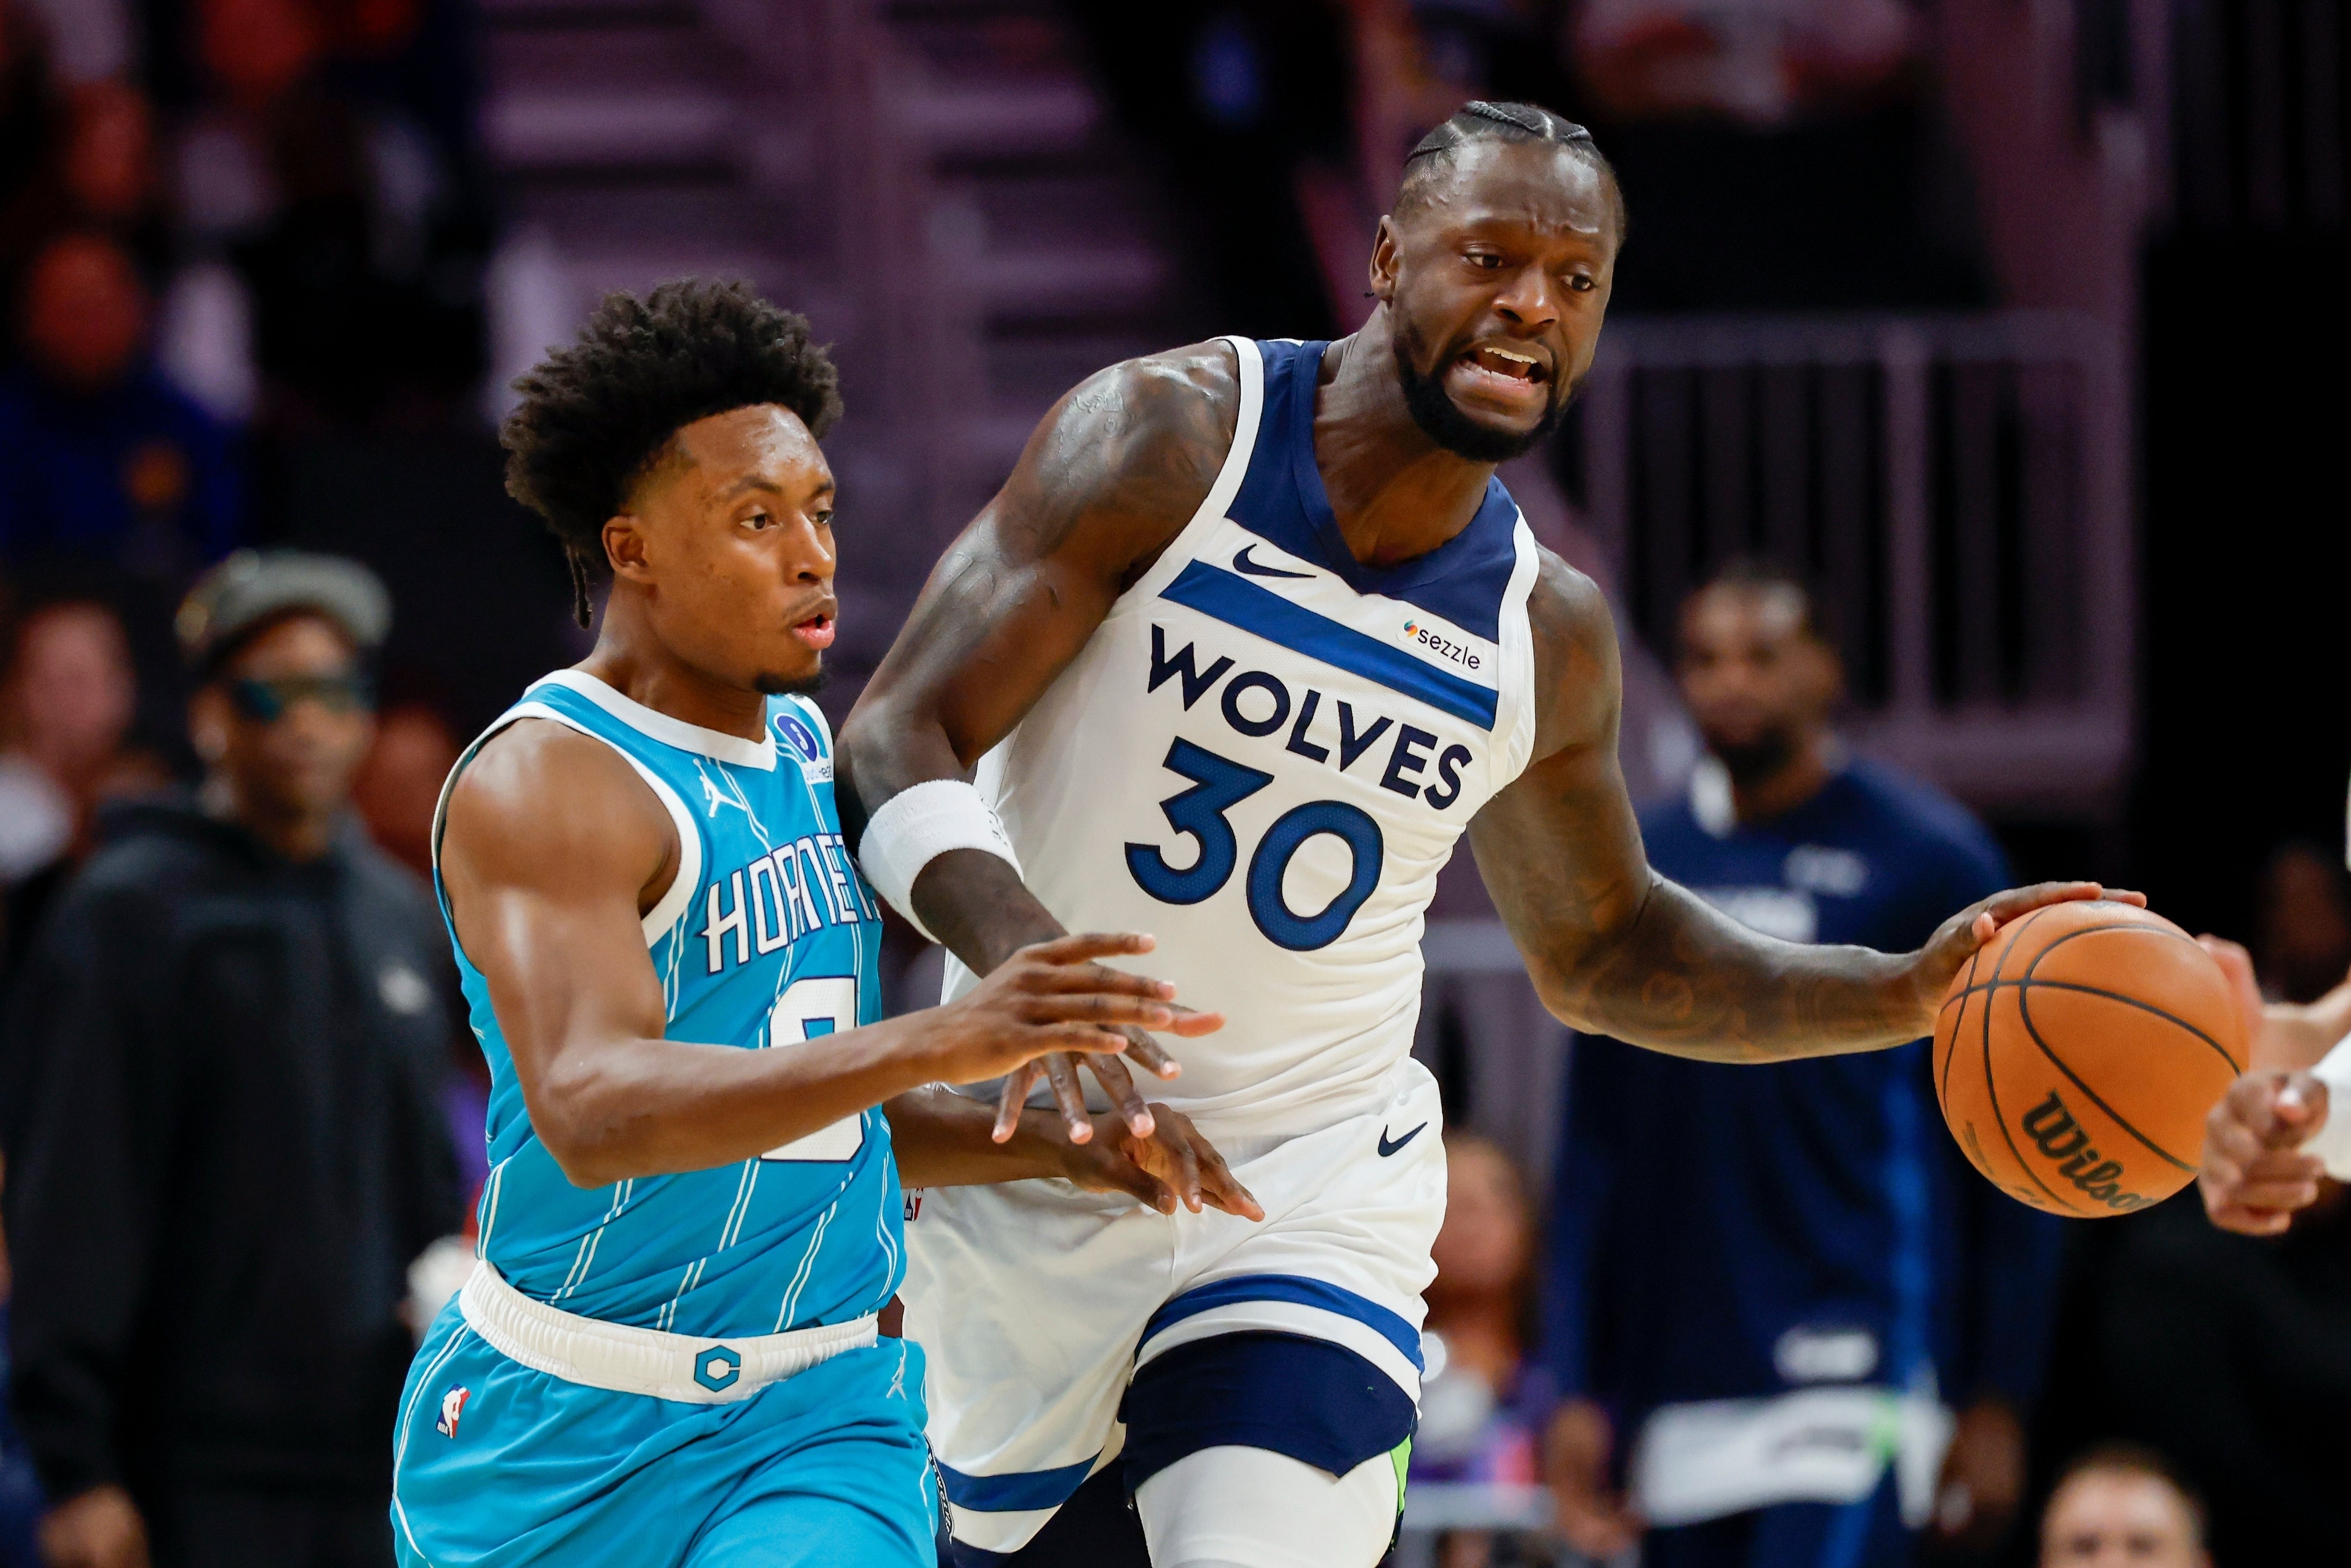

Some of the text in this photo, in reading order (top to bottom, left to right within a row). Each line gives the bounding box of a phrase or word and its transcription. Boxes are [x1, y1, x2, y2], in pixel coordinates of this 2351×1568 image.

[1148, 623, 1473, 810] WOLVES
[1418, 629, 1480, 670] sezzle
[695, 832, 883, 974] HORNET
[1124, 735, 1384, 952] 30
